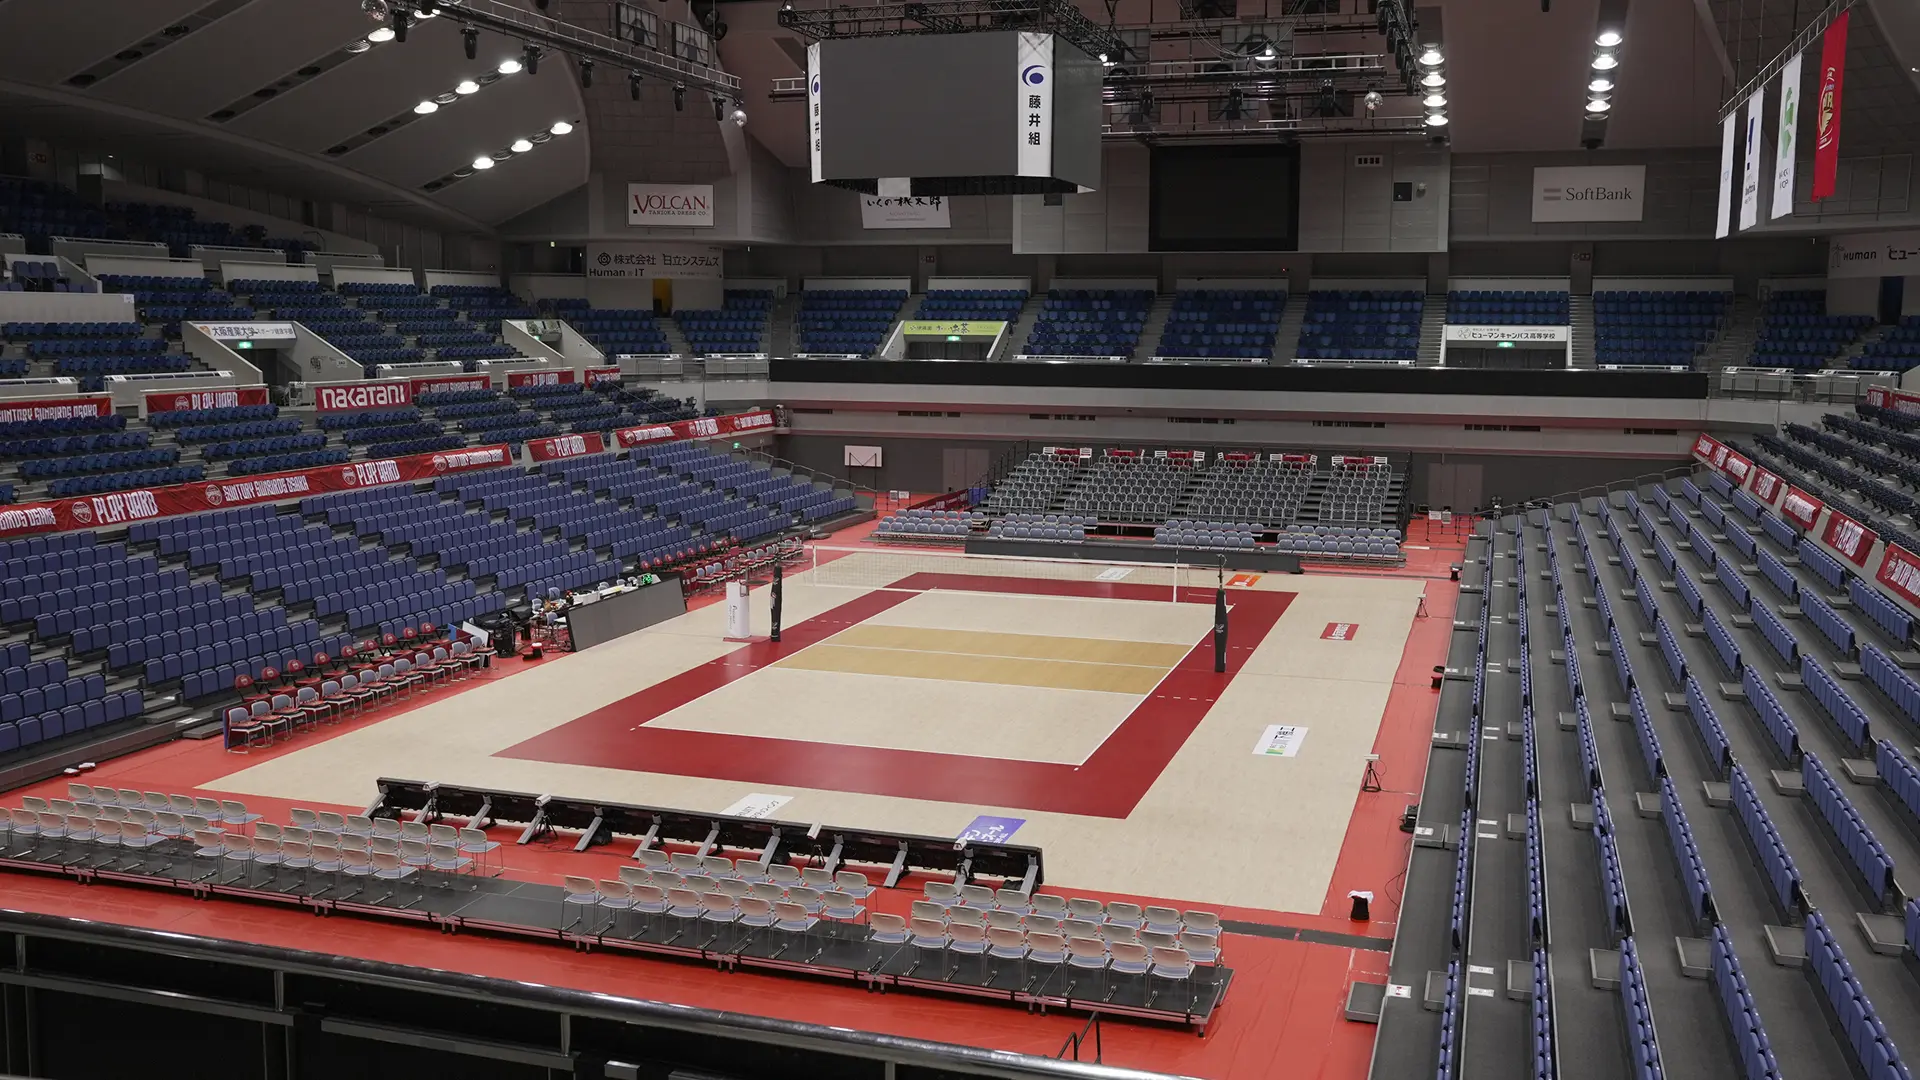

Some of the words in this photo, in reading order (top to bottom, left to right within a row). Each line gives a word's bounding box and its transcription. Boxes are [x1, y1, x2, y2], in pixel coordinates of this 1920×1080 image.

[1028, 94, 1041, 146] 藤井組
[1566, 187, 1632, 201] SoftBank
[633, 194, 706, 214] VOLCAN
[613, 254, 656, 265] 株式会社
[662, 253, 719, 267] 日立システムズ
[1886, 244, 1920, 260] ヒュー
[589, 268, 626, 277] Human
[635, 268, 645, 277] IT
[0, 407, 33, 423] UNTORY
[355, 461, 379, 486] PLAY
[376, 459, 401, 483] HARD
[222, 481, 256, 502] SUNTORY
[91, 494, 126, 524] PLAY
[123, 490, 159, 519] HARD
